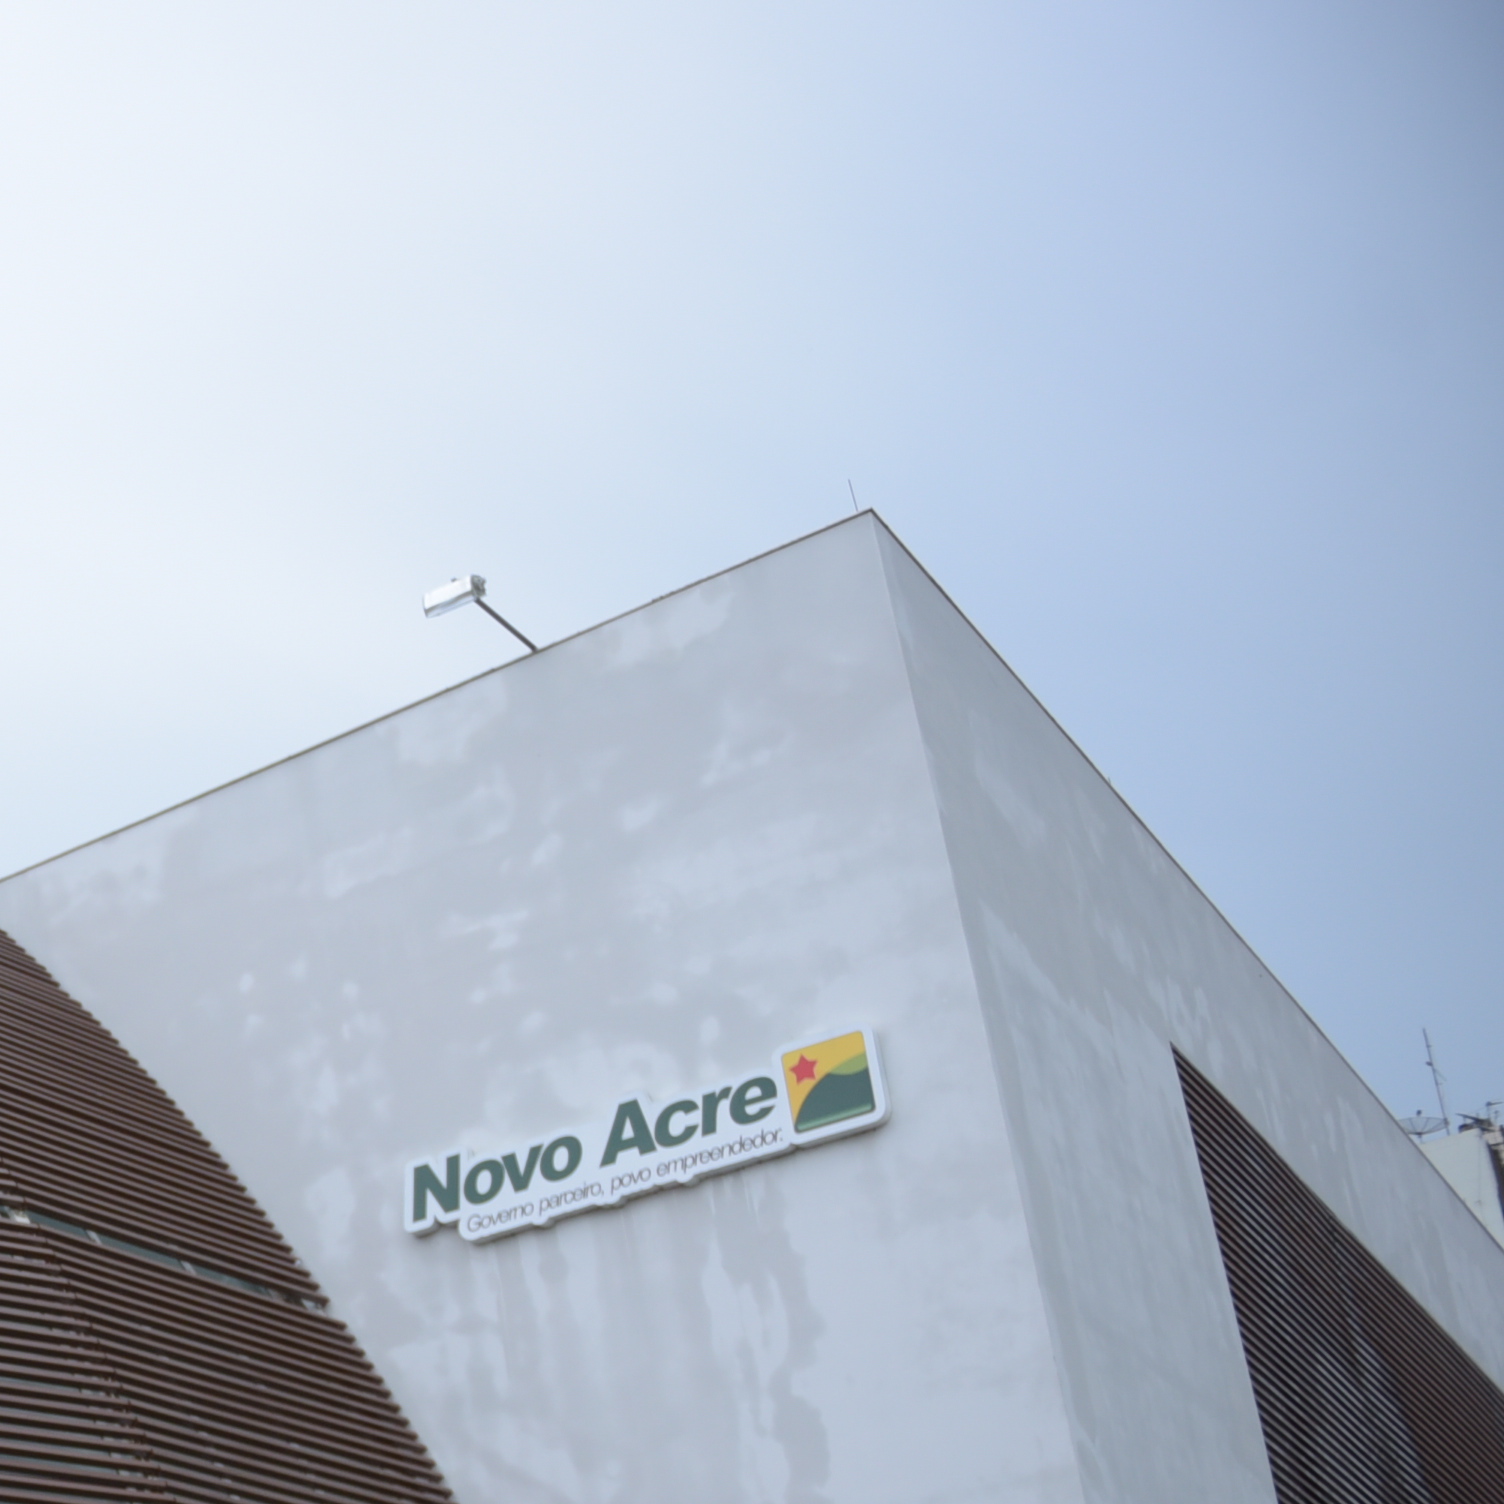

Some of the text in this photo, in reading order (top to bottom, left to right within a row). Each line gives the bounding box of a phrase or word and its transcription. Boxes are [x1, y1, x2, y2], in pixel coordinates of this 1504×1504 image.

[411, 1075, 778, 1223] Novo Acre
[466, 1203, 535, 1234] Governo
[536, 1182, 606, 1217] parceiro,
[609, 1166, 652, 1196] povo
